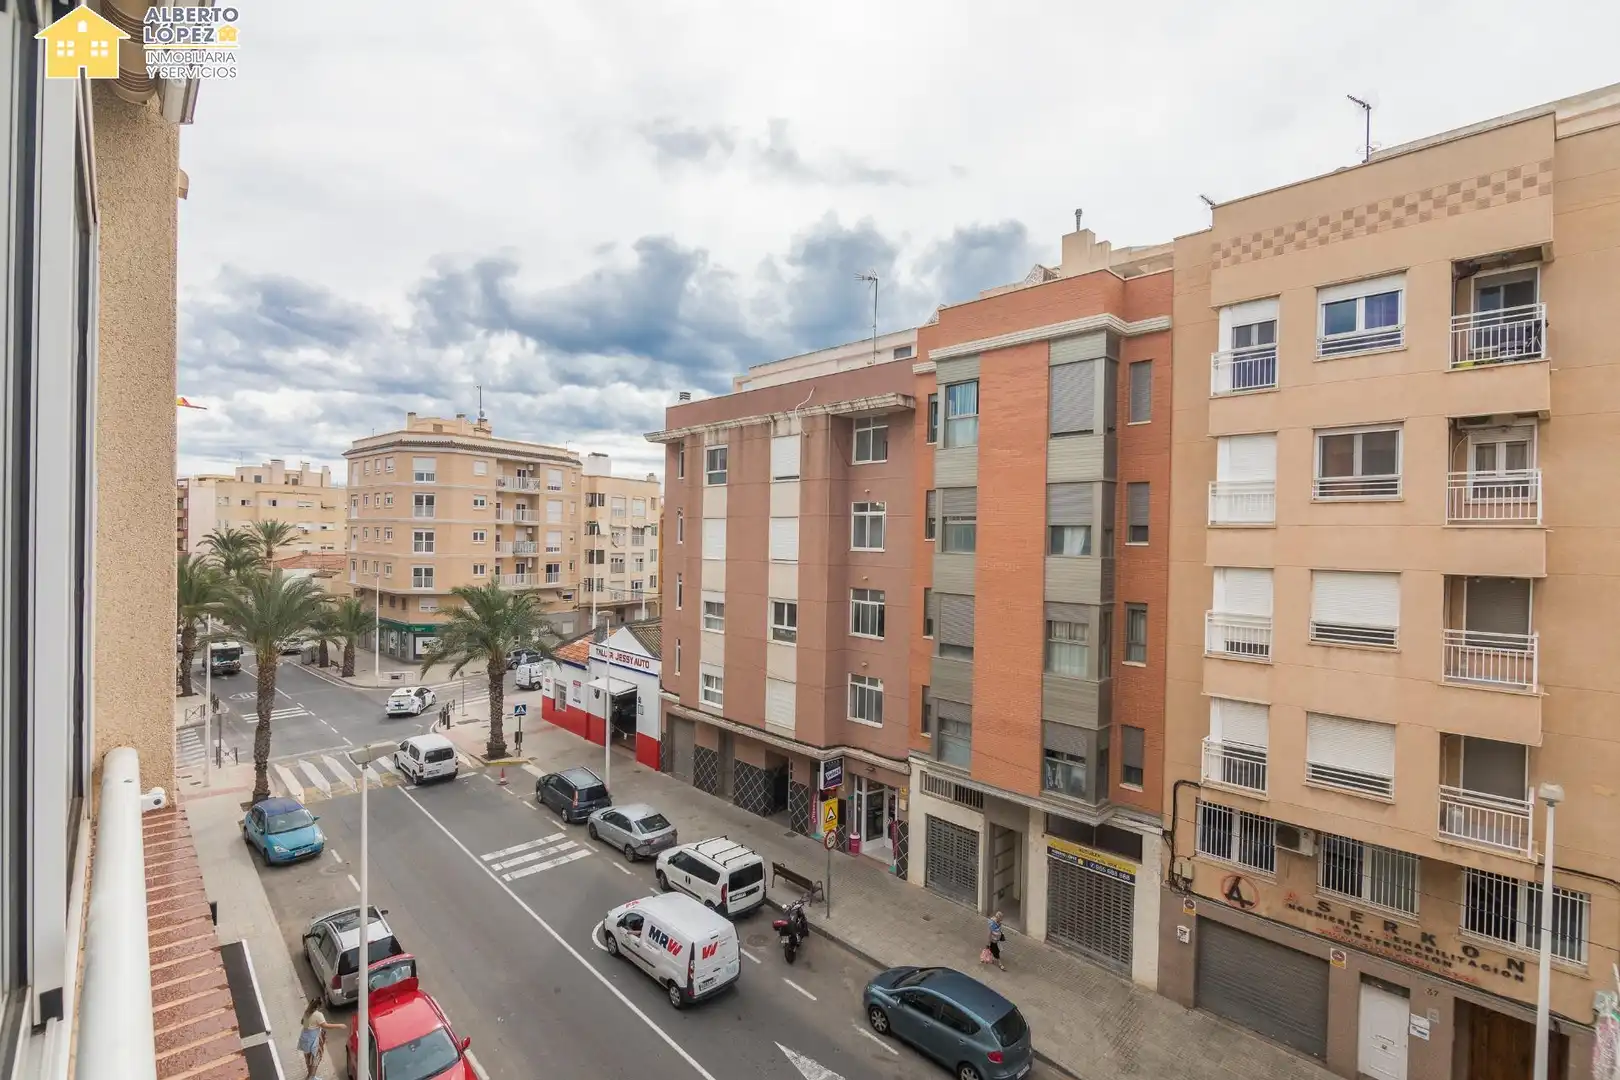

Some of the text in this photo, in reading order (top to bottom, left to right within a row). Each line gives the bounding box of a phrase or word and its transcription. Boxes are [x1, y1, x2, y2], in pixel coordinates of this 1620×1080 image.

[595, 648, 650, 669] TALLR JESSY AUTO
[648, 924, 684, 957] MRW
[1317, 900, 1525, 974] SERKON
